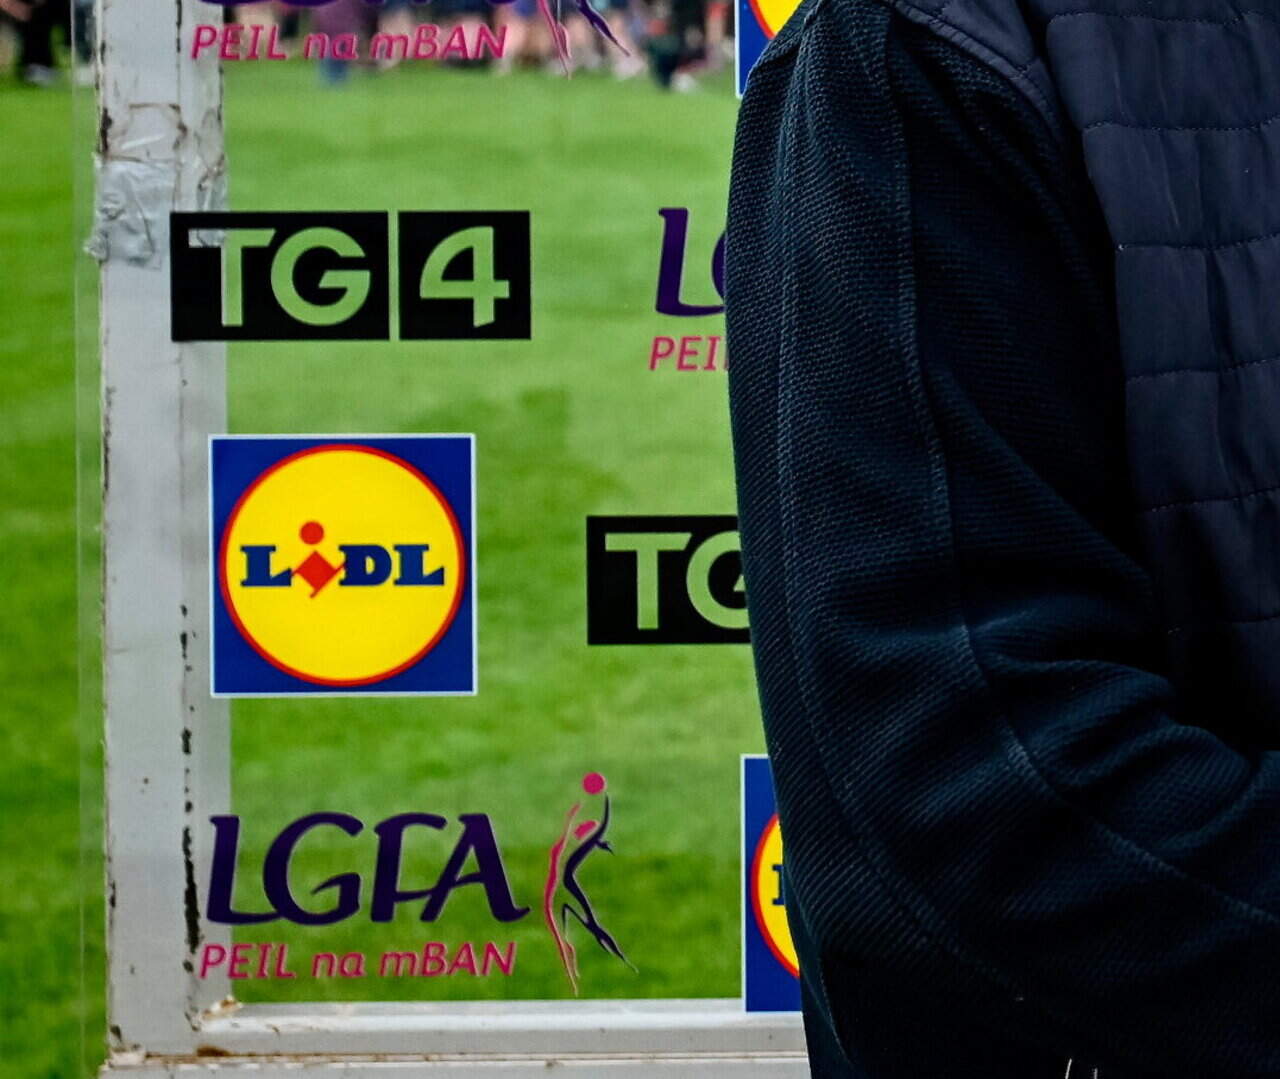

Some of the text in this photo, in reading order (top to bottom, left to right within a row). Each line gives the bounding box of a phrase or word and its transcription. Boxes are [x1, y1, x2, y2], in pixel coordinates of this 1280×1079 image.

[191, 24, 508, 61] PEIL na mBAN
[648, 335, 728, 371] PEI
[604, 530, 750, 630] TG
[204, 811, 531, 925] LGFA
[200, 943, 517, 980] PEIL na mBAN
